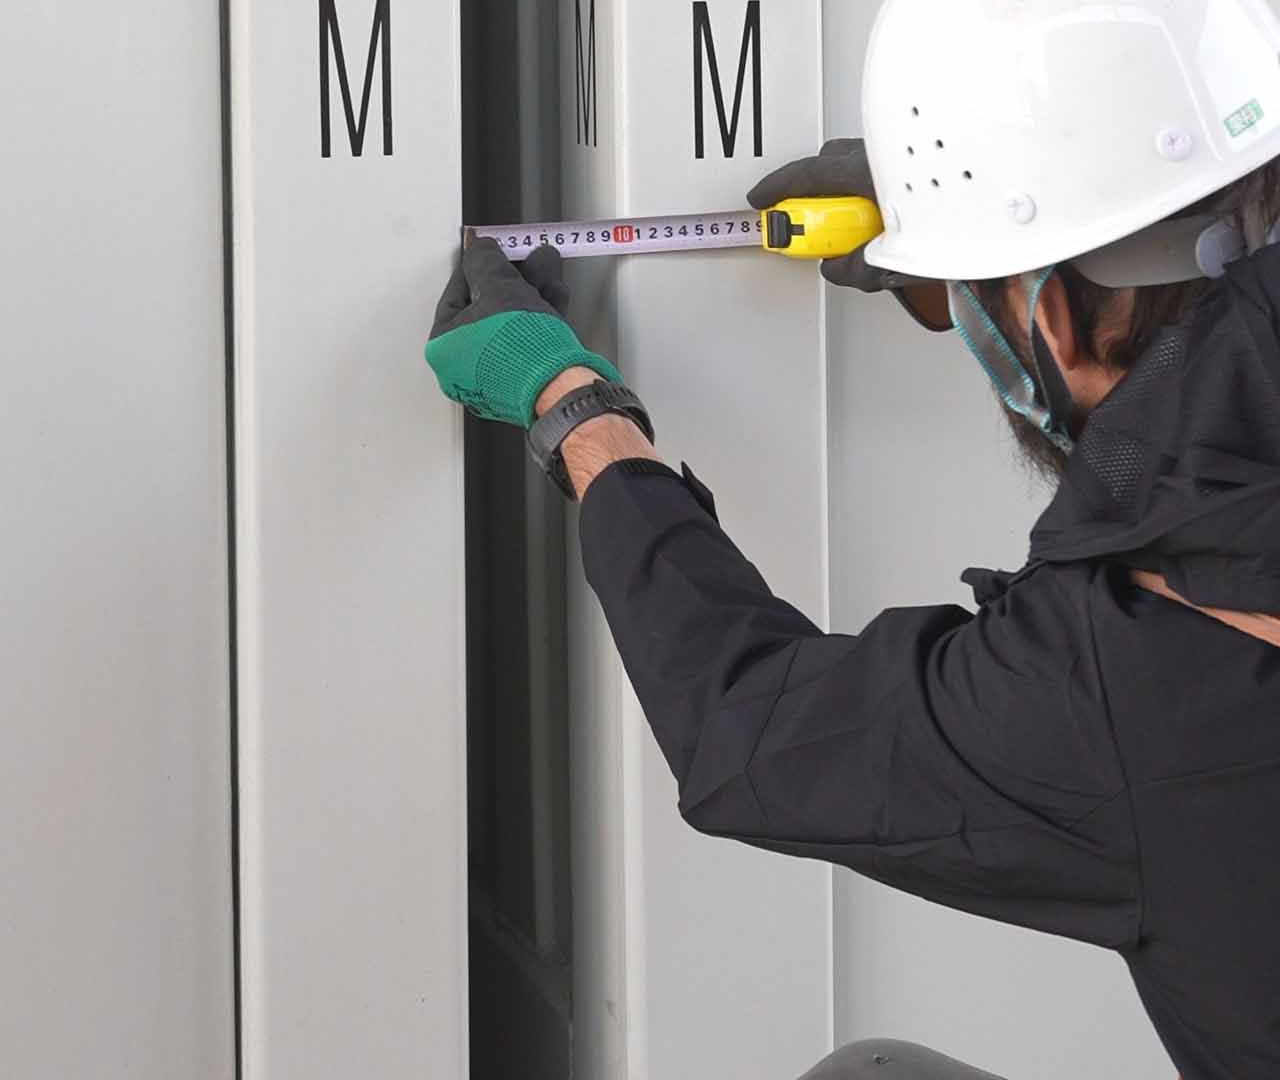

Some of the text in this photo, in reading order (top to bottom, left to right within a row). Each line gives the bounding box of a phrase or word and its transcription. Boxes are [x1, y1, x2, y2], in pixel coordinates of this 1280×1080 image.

[507, 236, 518, 248] 3
[522, 235, 532, 247] 4
[555, 233, 565, 245] 6
[570, 232, 580, 244] 7
[586, 231, 596, 243] 8
[601, 230, 611, 242] 9
[649, 227, 658, 239] 2
[664, 226, 673, 238] 3
[678, 225, 688, 237] 4
[695, 224, 705, 236] 5
[710, 223, 720, 235] 6
[725, 222, 735, 234] 7
[740, 221, 750, 233] 8
